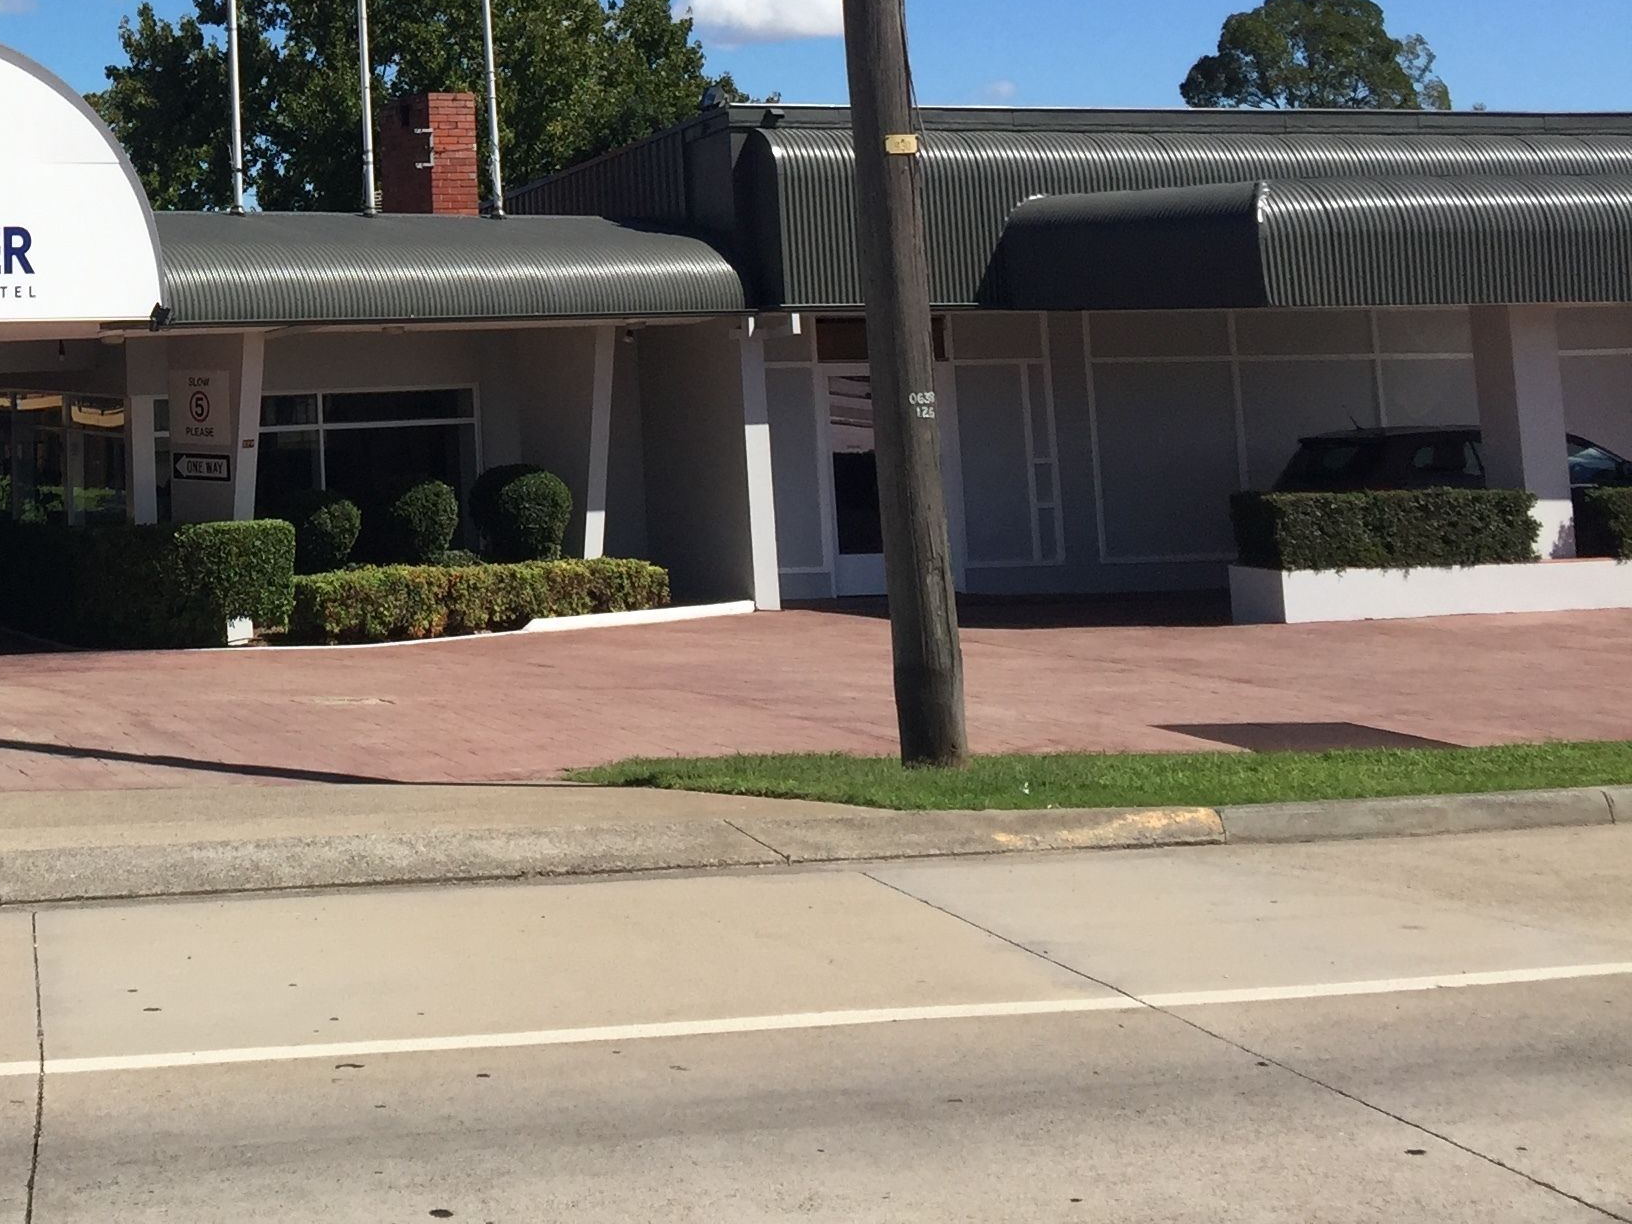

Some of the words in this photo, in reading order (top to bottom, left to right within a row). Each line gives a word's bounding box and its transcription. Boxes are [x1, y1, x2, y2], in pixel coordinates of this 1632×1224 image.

[188, 377, 210, 387] SLOW
[194, 397, 204, 417] 5
[185, 427, 214, 437] PLEASE
[186, 460, 203, 474] ONE
[205, 461, 223, 474] WAY
